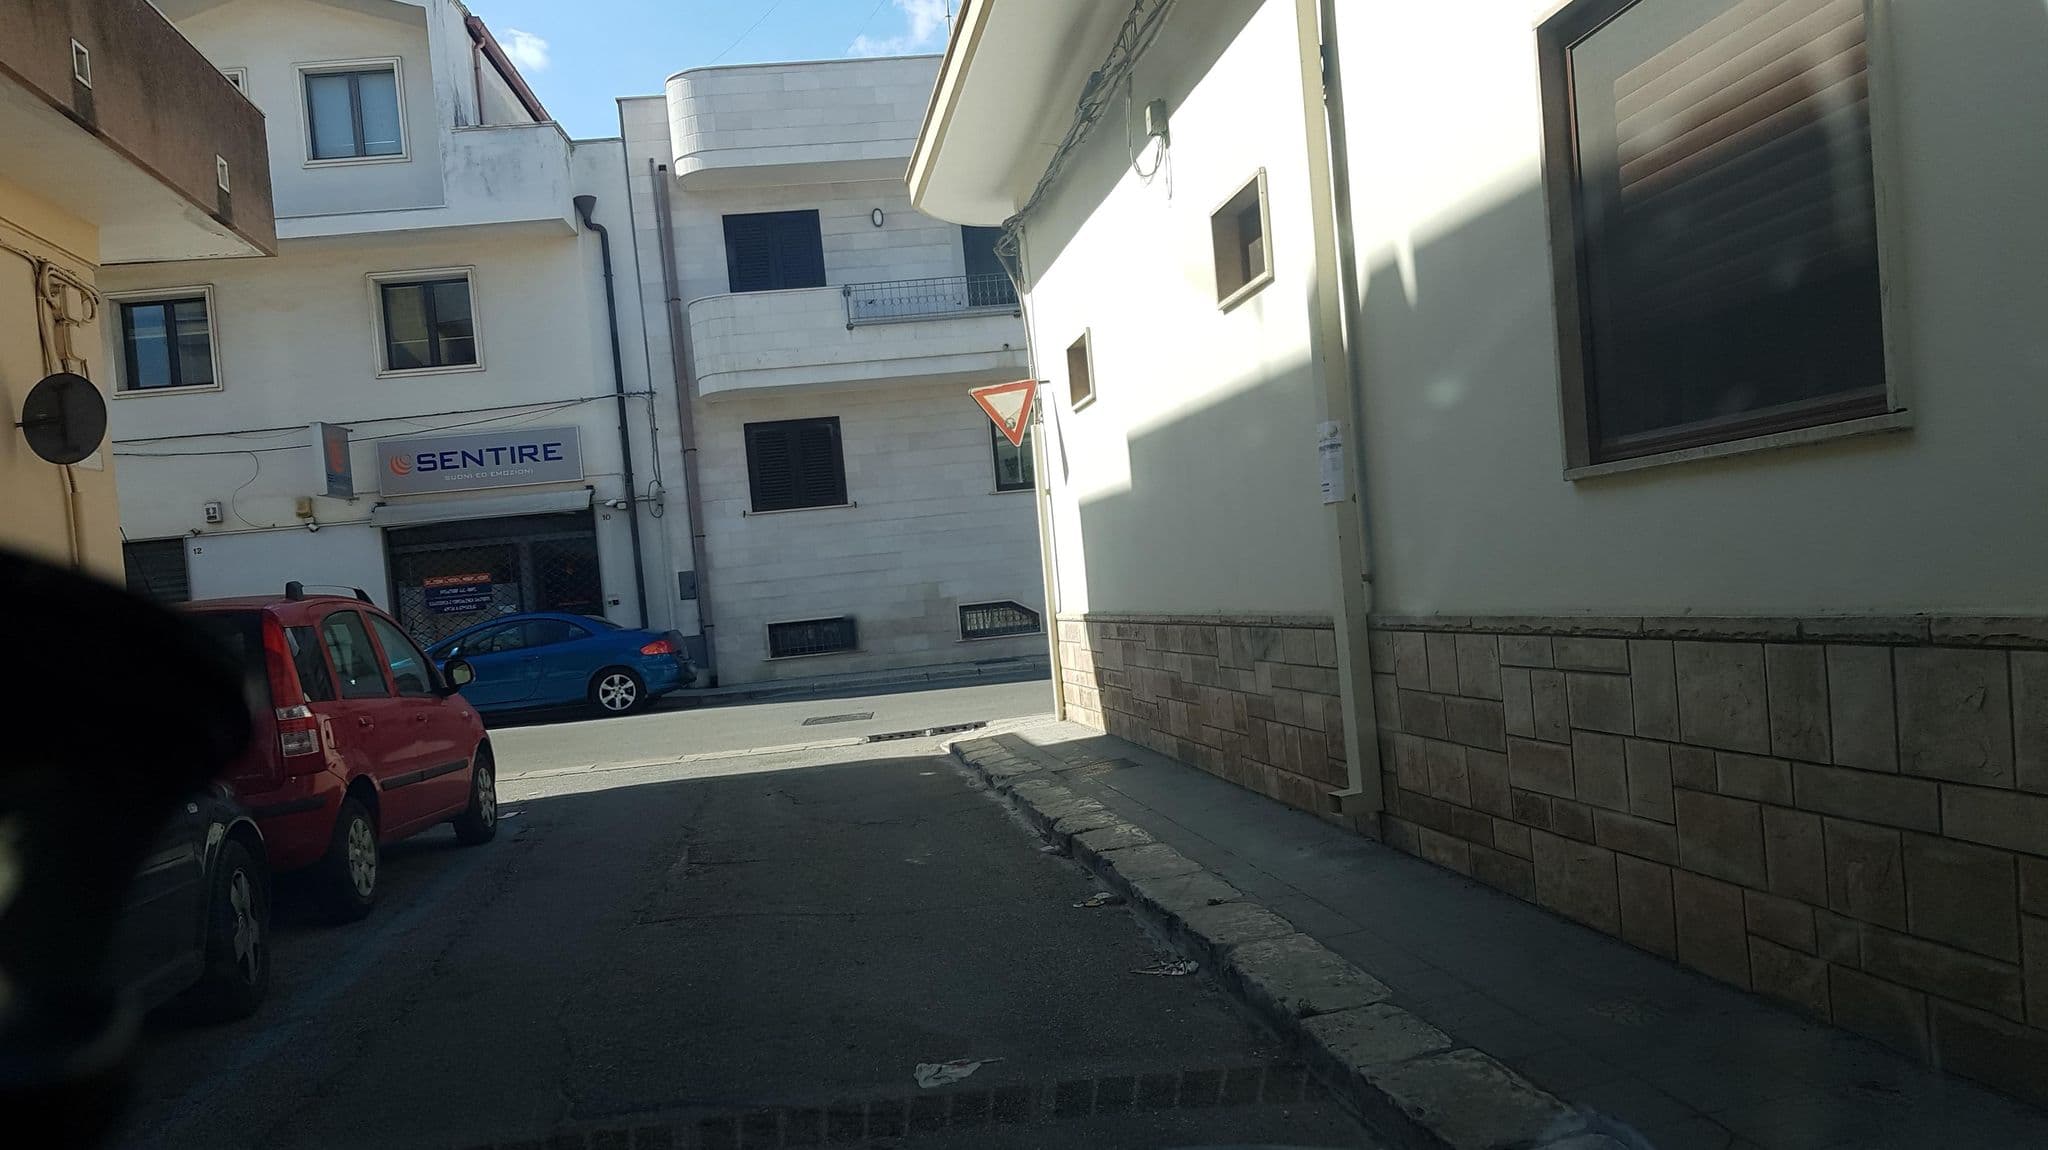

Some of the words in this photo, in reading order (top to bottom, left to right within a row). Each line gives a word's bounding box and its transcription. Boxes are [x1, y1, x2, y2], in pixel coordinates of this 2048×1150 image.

[416, 442, 563, 472] SENTIRE
[444, 472, 473, 481] SUONI
[490, 468, 534, 477] EMOZIONI
[193, 547, 202, 555] 12
